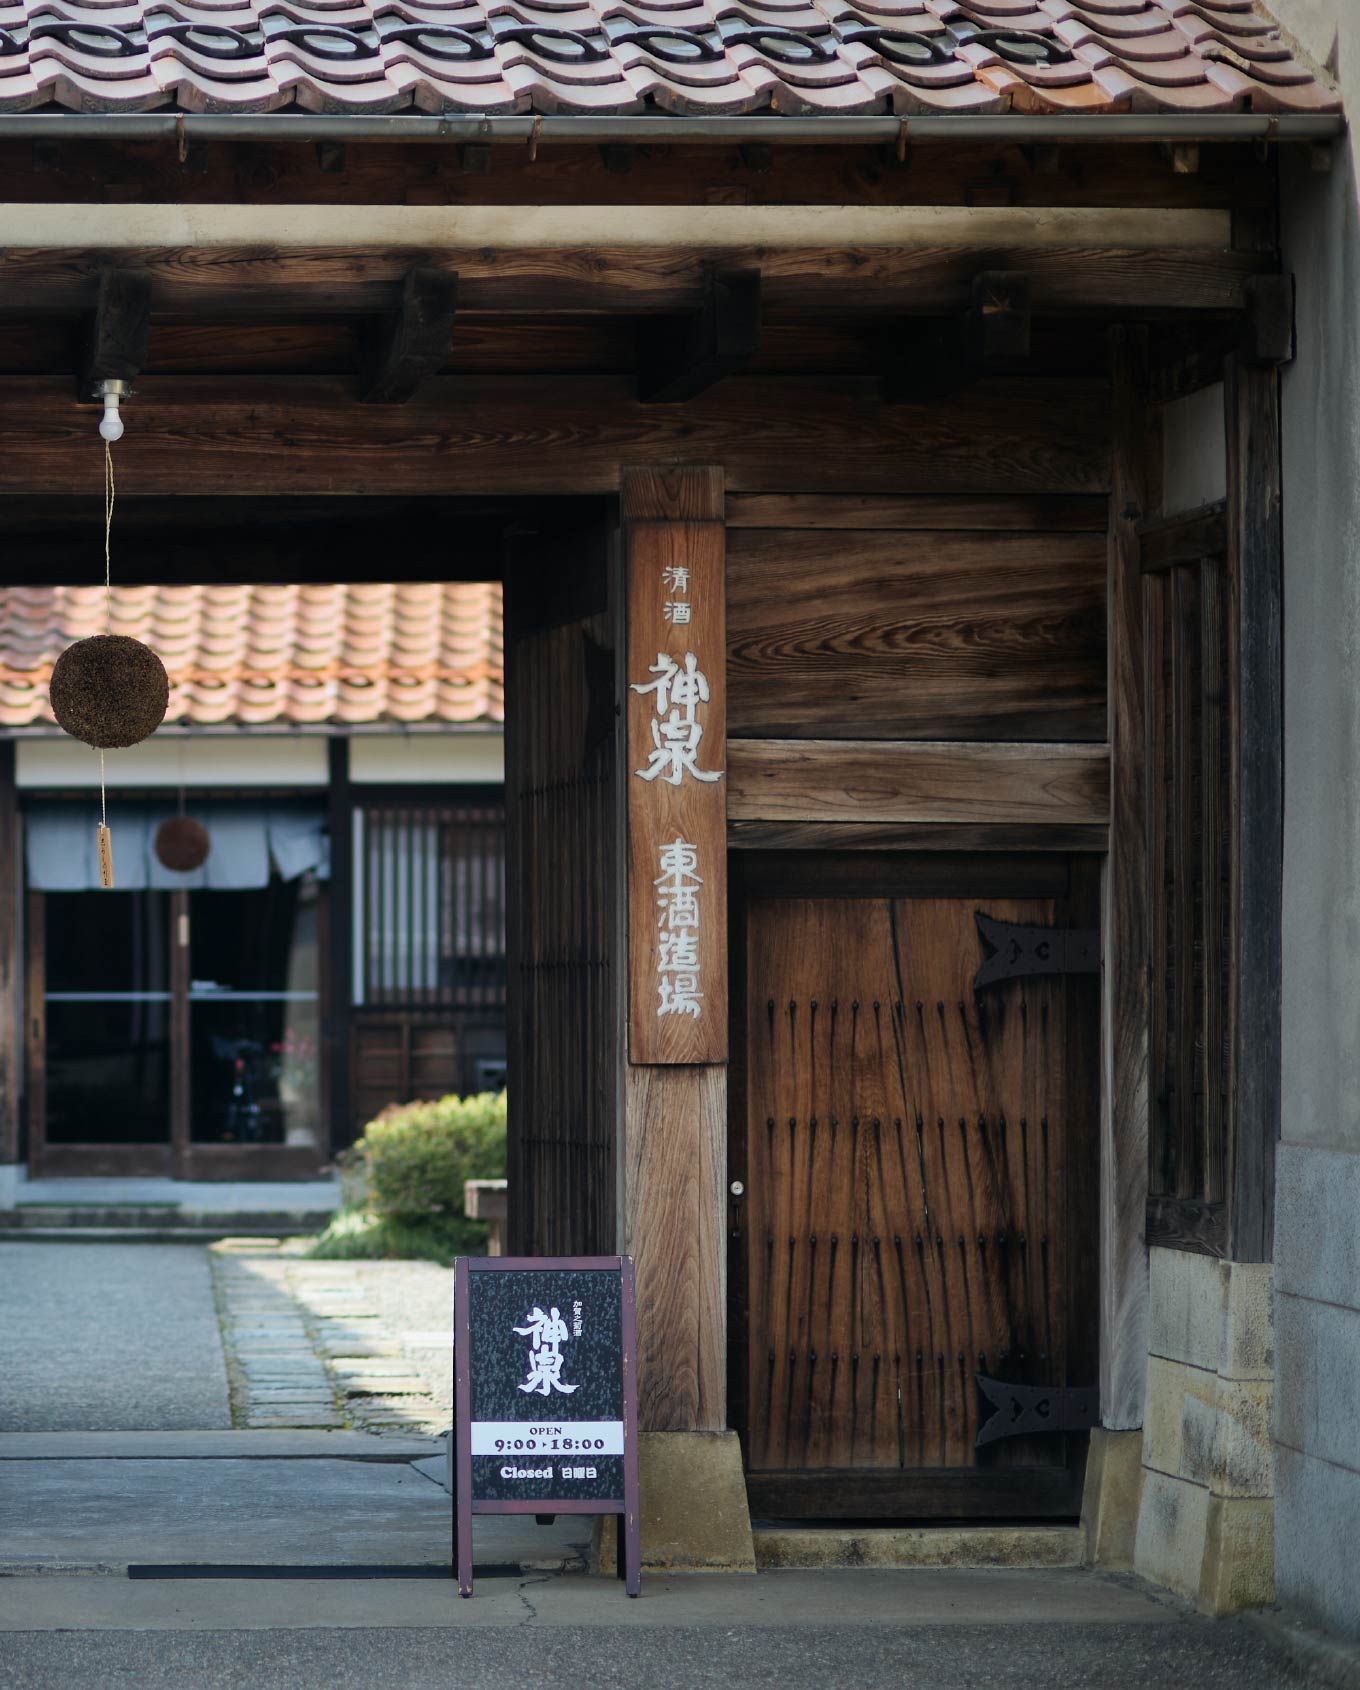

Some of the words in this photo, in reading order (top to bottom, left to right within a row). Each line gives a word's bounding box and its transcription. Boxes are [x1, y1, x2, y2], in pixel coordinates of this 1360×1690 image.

[662, 566, 691, 625] 清酒
[630, 651, 724, 786] 神泉
[653, 837, 704, 1020] 東酒造場
[512, 1306, 580, 1396] 神泉
[494, 1439, 537, 1452] 9:00
[550, 1438, 605, 1450] 18:00
[529, 1427, 562, 1435] OPEN
[500, 1466, 554, 1479] Closed
[561, 1466, 597, 1479] 日曜日
